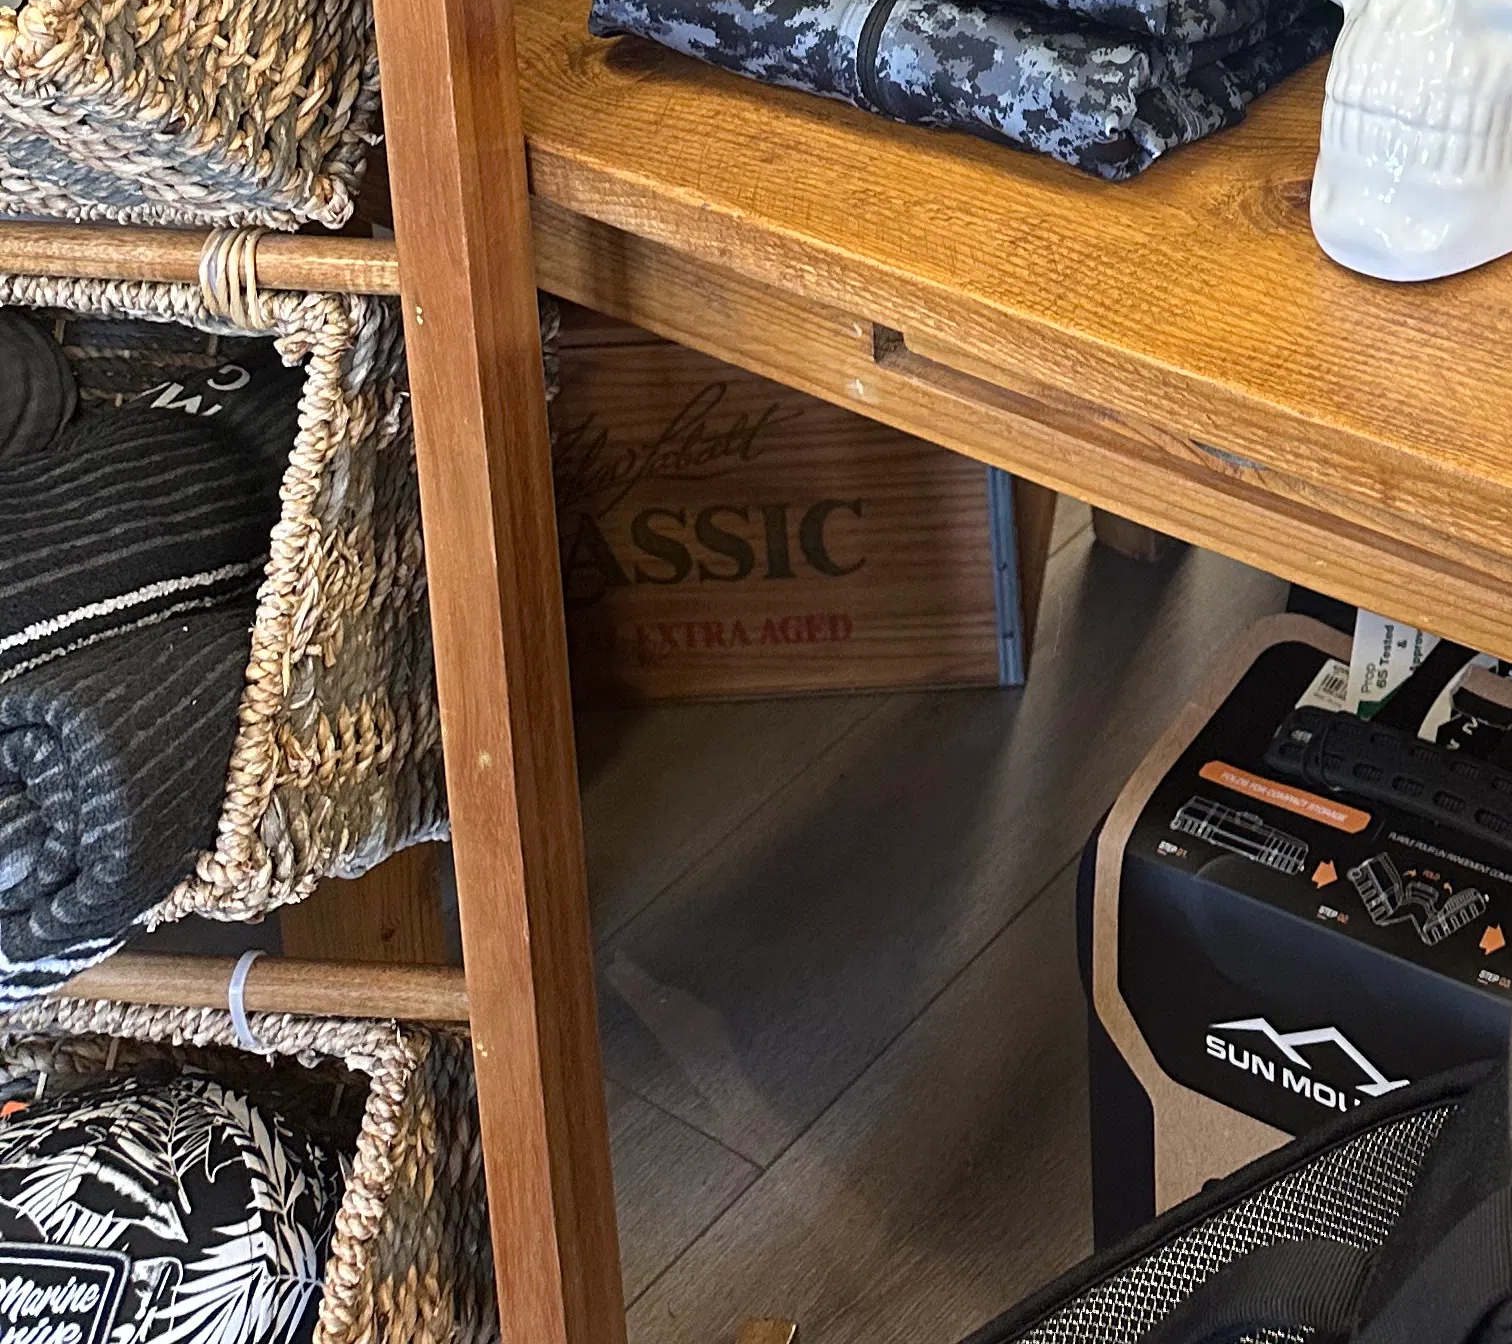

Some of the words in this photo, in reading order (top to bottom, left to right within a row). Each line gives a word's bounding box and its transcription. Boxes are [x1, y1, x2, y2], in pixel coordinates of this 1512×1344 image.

[759, 611, 853, 647] AGED
[1205, 1033, 1275, 1083] SUN
[0, 1275, 101, 1324] Marine
[0, 1316, 83, 1344] rive
